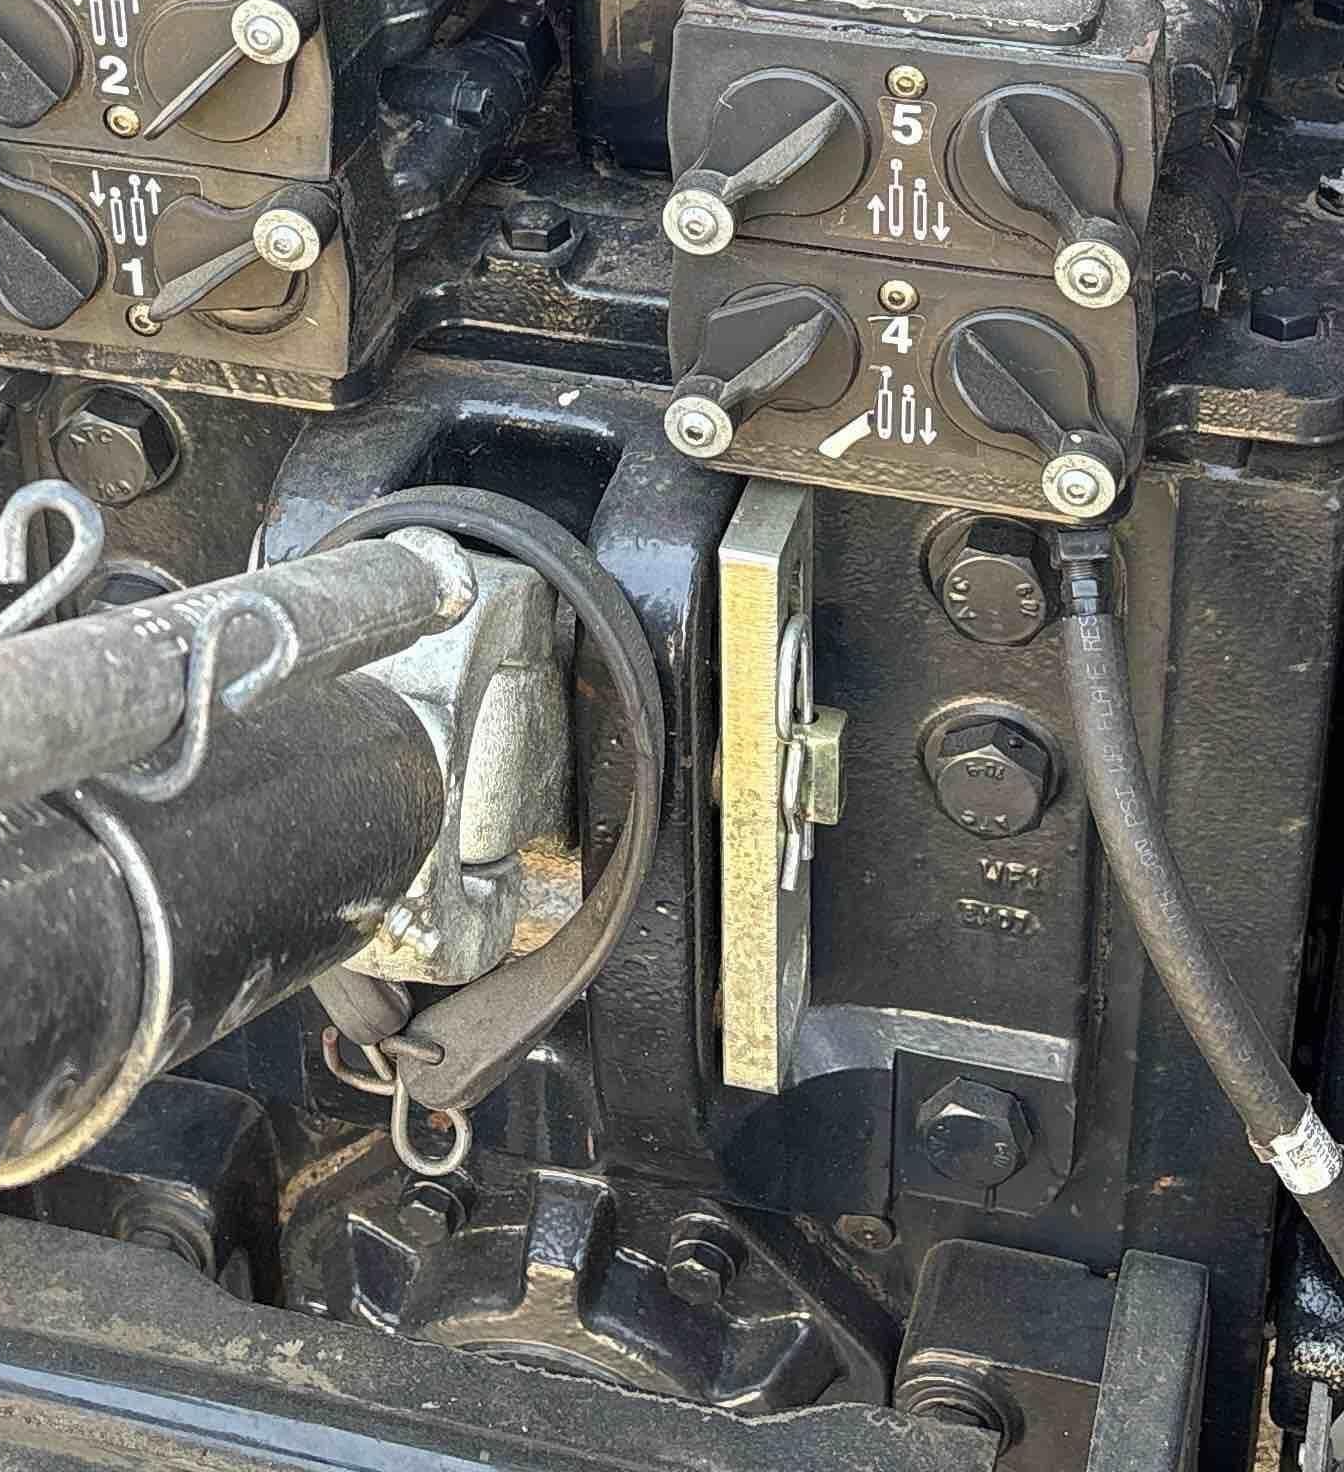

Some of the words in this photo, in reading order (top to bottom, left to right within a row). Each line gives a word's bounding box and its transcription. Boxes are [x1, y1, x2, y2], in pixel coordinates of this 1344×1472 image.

[98, 54, 131, 96] 2
[891, 103, 924, 146] 5
[121, 257, 145, 297] 1
[881, 315, 913, 355] 4
[1113, 784, 1148, 829] PSI
